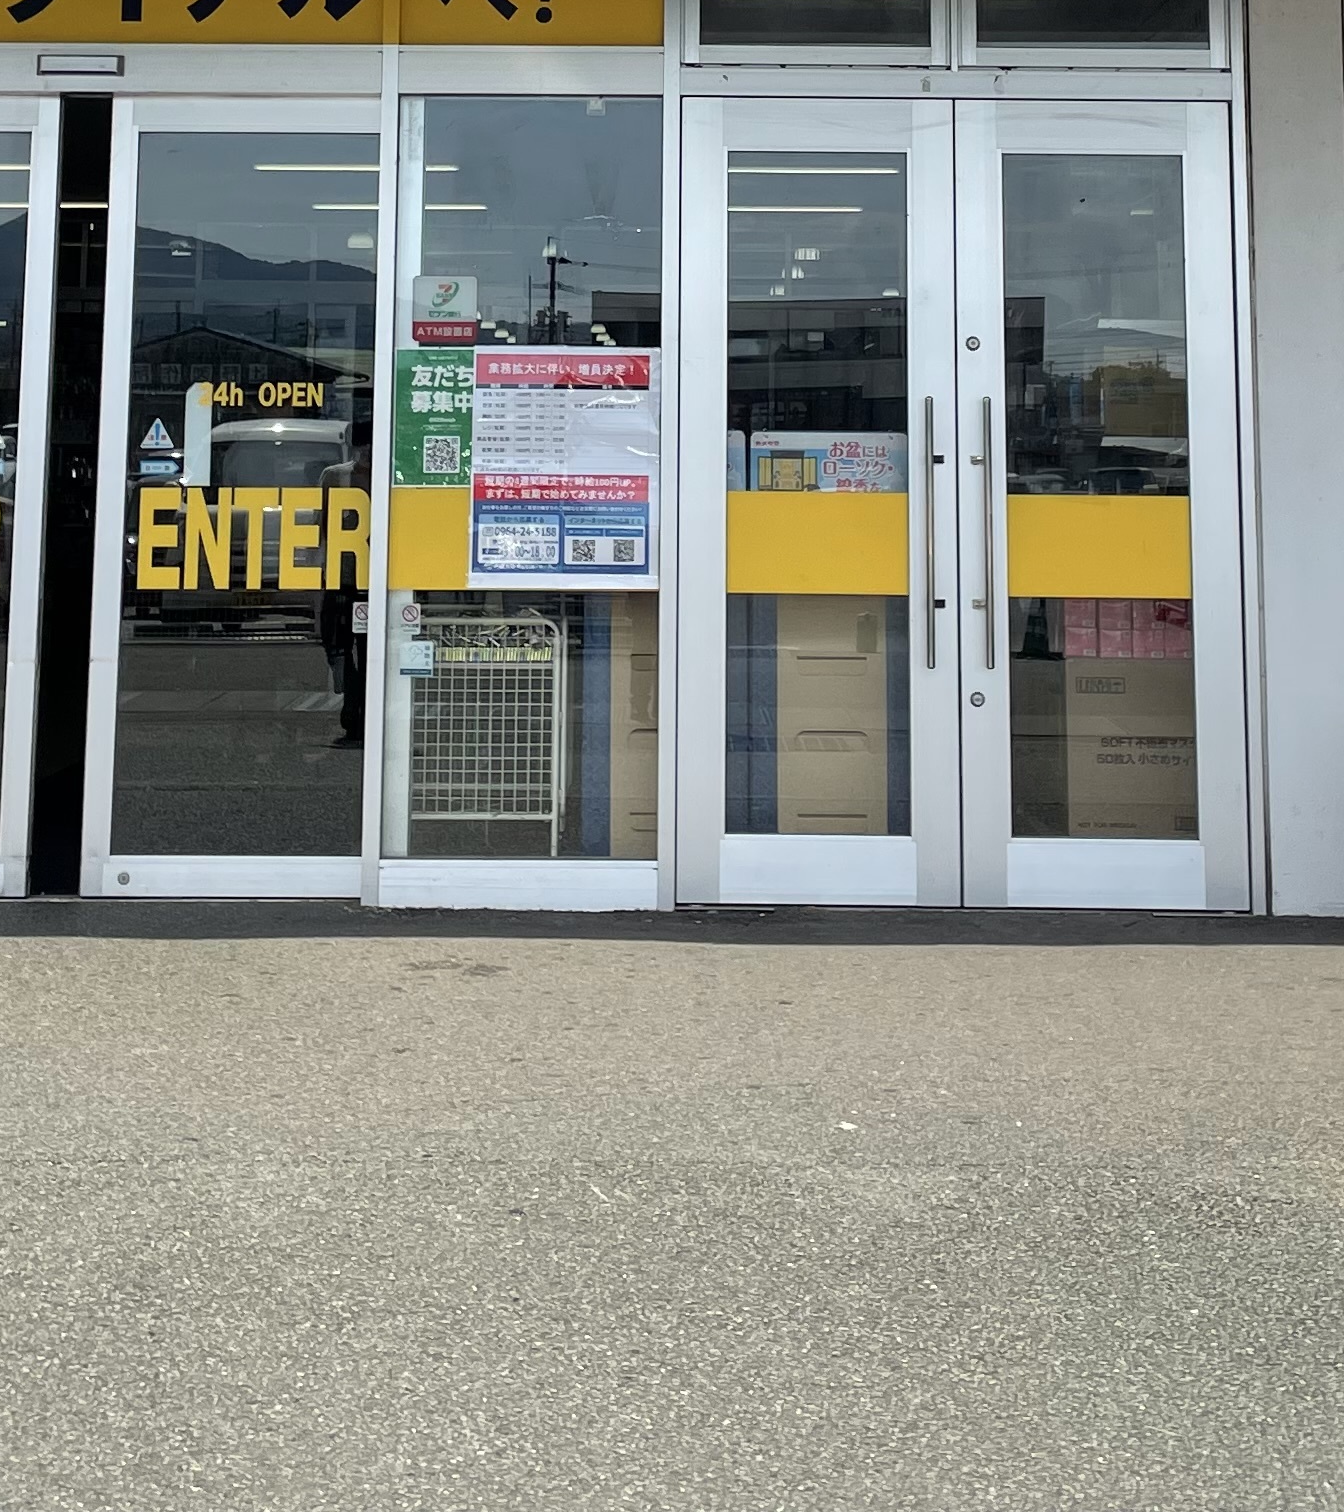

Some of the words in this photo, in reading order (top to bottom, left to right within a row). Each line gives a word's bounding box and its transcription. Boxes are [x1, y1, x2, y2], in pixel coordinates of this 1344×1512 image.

[411, 364, 474, 387] 友だち
[201, 381, 244, 407] 24h
[258, 381, 324, 407] OPEN
[411, 391, 474, 413] 募集中
[828, 440, 888, 459] お盆には
[136, 487, 370, 590] ENTER
